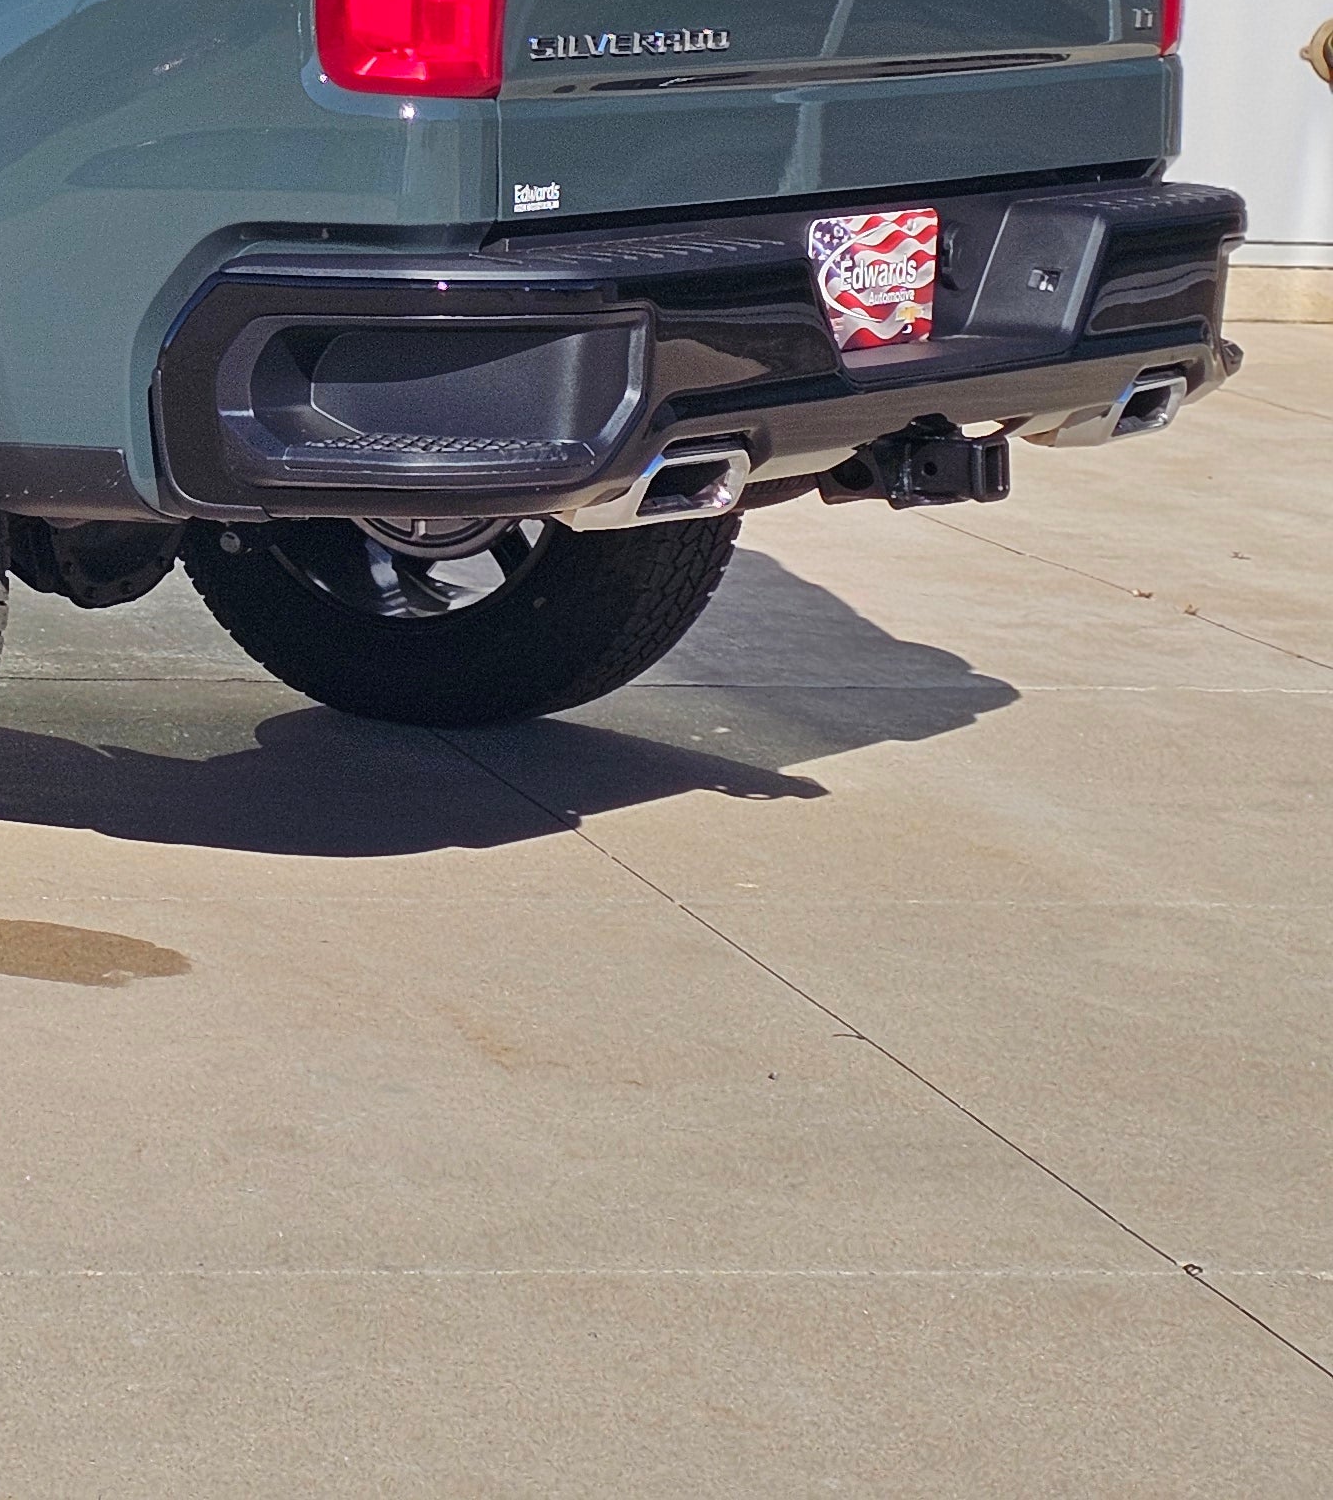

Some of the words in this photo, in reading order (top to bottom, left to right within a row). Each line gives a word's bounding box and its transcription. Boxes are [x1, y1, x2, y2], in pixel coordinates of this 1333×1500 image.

[528, 28, 731, 60] SILVERADO
[514, 181, 561, 204] Edwards
[840, 254, 917, 291] Edwards
[869, 290, 915, 304] Automotive
